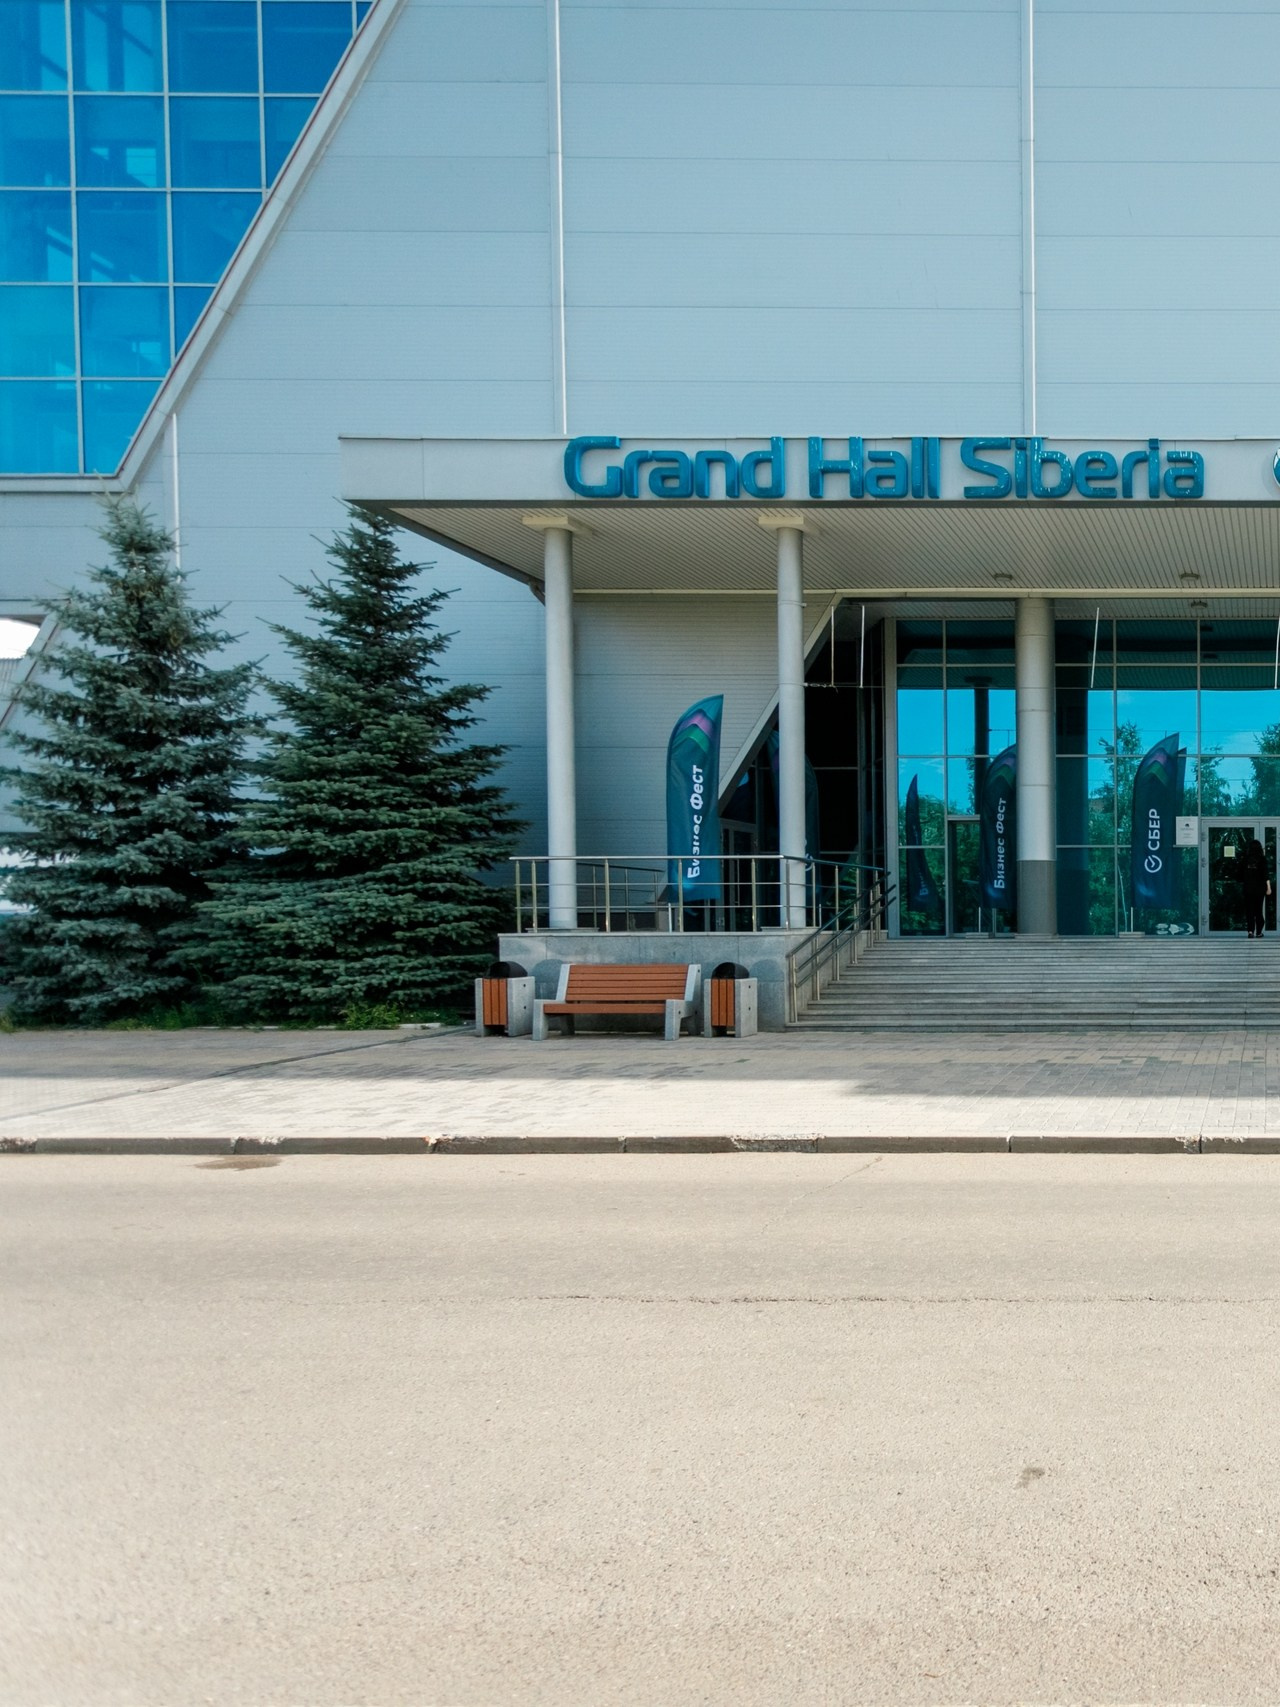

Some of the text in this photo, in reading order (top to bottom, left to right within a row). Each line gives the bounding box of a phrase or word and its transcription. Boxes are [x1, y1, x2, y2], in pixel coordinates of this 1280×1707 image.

[564, 436, 1205, 499] Grand Hall Siberia
[690, 764, 704, 810] Фест
[993, 797, 1007, 889] Бизнес Фест
[1147, 808, 1160, 851] СБЕР
